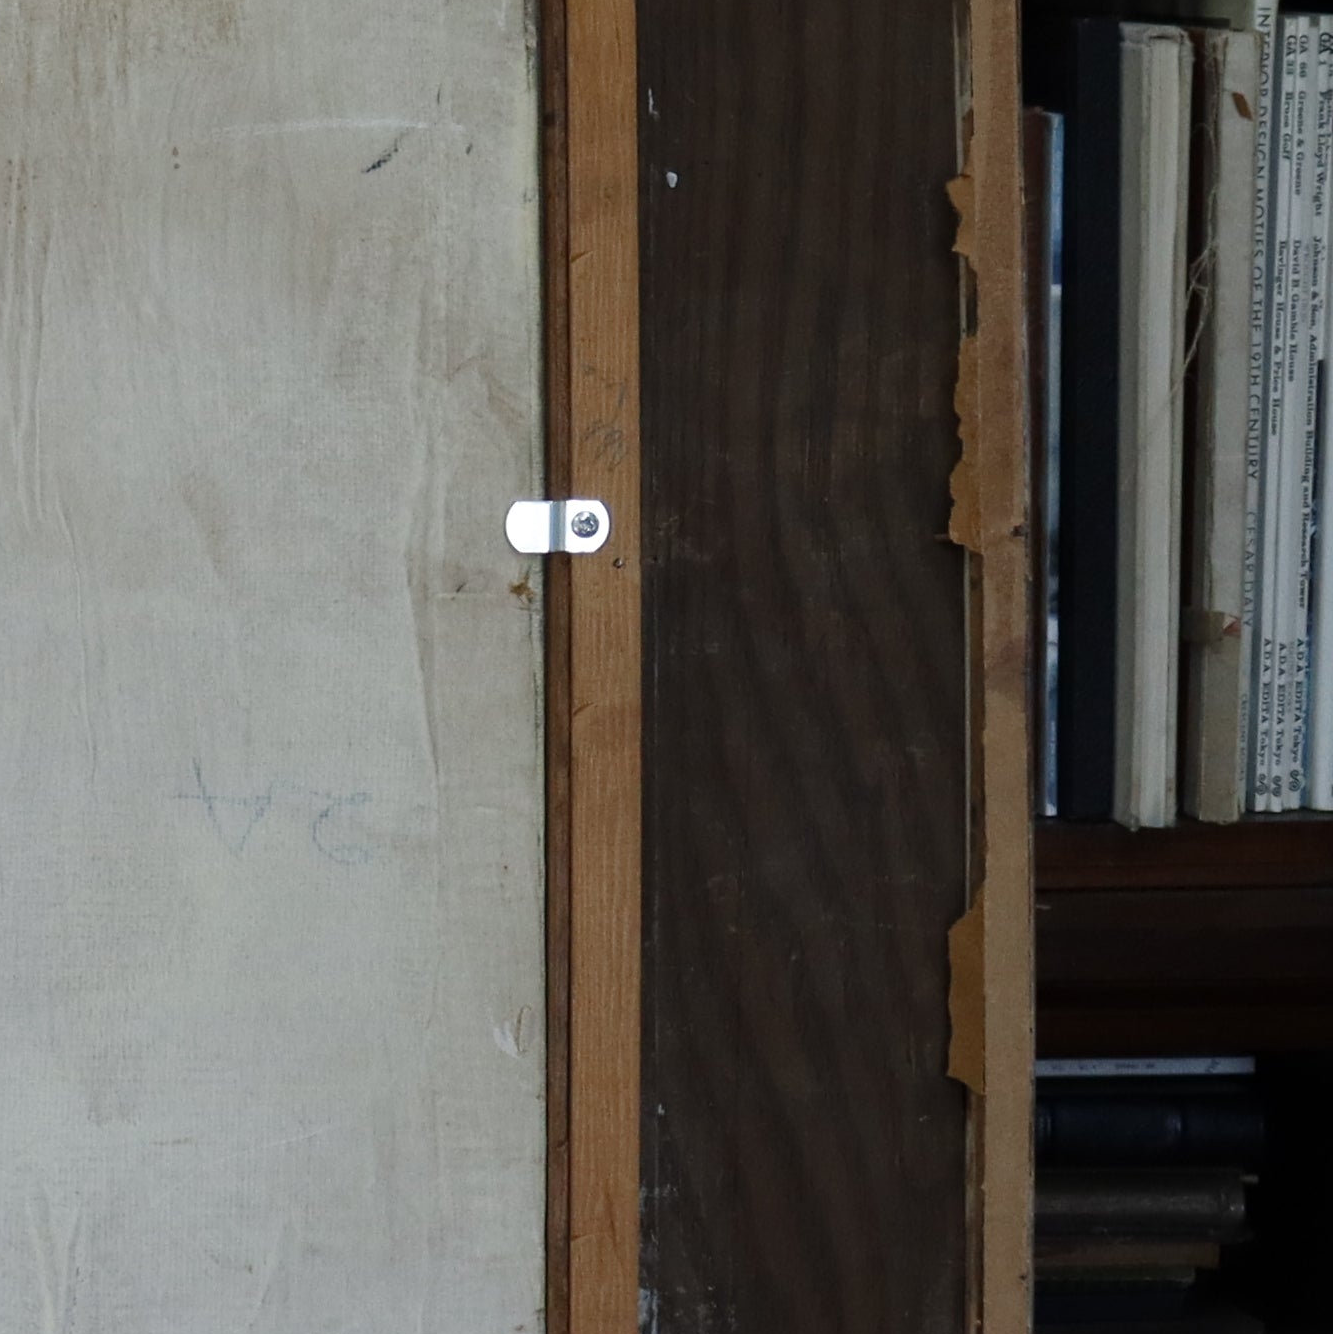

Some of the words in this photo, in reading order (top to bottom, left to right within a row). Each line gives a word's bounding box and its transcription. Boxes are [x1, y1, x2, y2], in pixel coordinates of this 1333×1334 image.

[1285, 34, 1297, 57] GA
[1298, 34, 1310, 55] GA
[1283, 91, 1294, 129] Bruce
[1295, 90, 1307, 134] Greene
[1315, 89, 1331, 130] Frank
[1281, 132, 1293, 162] Goff
[1313, 133, 1327, 169] Lloyd
[1293, 150, 1305, 196] Greene
[1312, 170, 1325, 217] Wright
[1291, 239, 1303, 276] David
[1310, 236, 1323, 287] Johnson
[1250, 296, 1263, 332] THE
[1273, 301, 1284, 342] House
[1247, 341, 1262, 388] 19TH
[1271, 360, 1282, 394] Price
[1287, 343, 1299, 383] House
[1246, 394, 1260, 479] CENTURY
[1270, 397, 1281, 437] House
[1301, 430, 1314, 485] Building
[1300, 487, 1312, 510] and
[1297, 571, 1310, 610] Tower
[1261, 681, 1271, 723] EDITA
[1276, 684, 1287, 725] EDITA
[1294, 680, 1304, 723] EDITA
[1258, 729, 1270, 766] Tokyo
[1273, 728, 1285, 766] Tokyo
[1290, 725, 1302, 764] Tokyo
